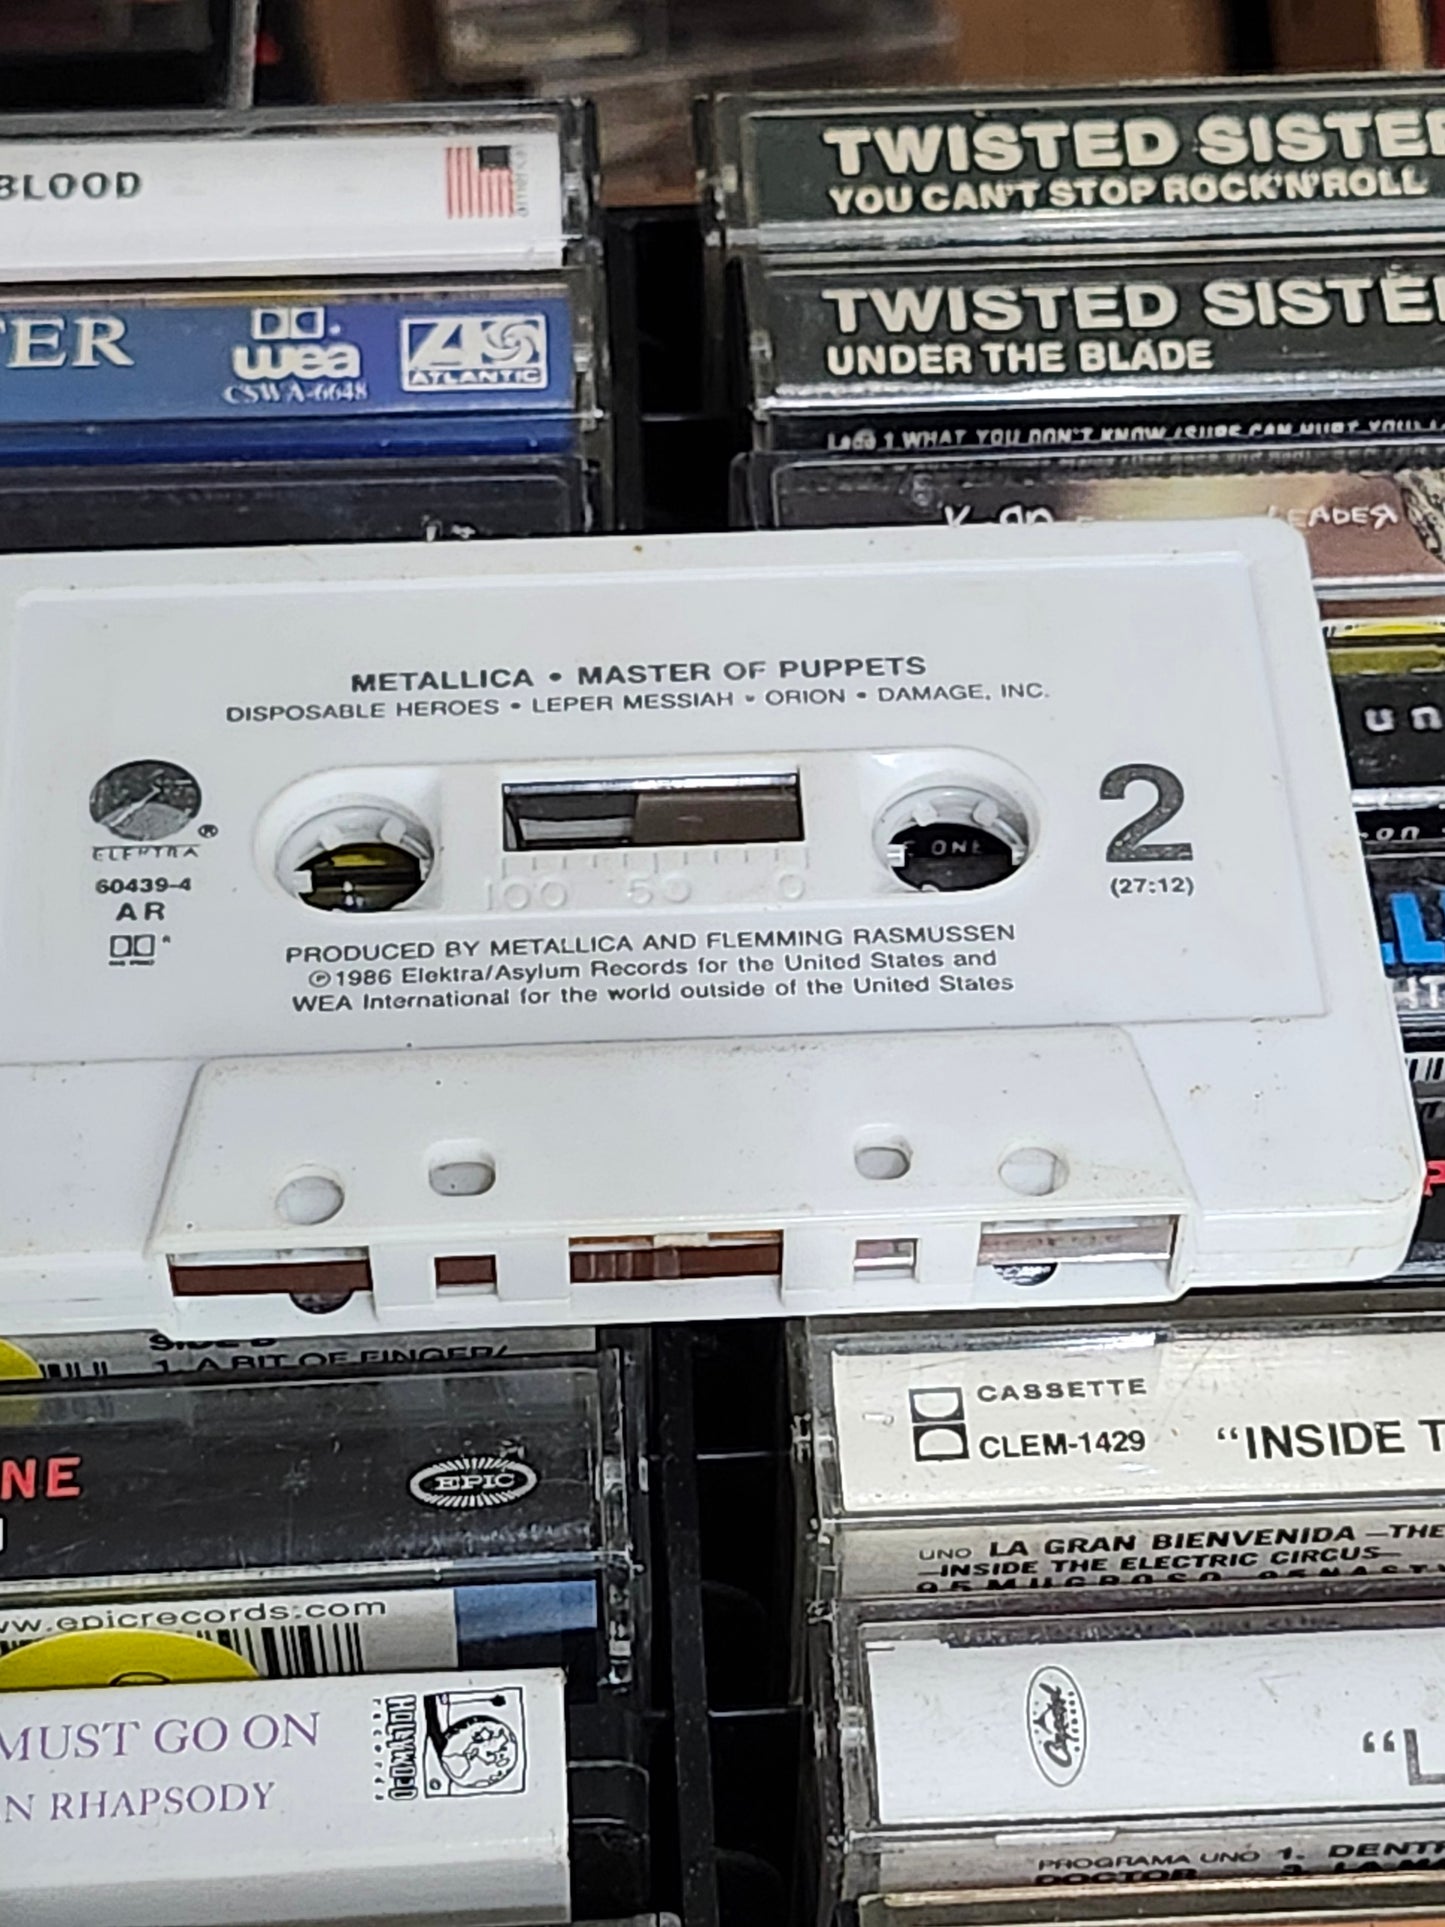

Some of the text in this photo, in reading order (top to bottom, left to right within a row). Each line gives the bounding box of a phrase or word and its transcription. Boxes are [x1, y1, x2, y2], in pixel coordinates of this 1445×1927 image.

[823, 118, 1180, 176] TWISTED
[0, 172, 141, 200] BLOOD
[828, 183, 918, 215] YOU
[922, 180, 1038, 211] CAN'T
[1049, 174, 1150, 208] STOP
[822, 283, 1179, 334] TWISTED
[0, 316, 135, 368] ER
[826, 338, 1214, 376] UNDER THE BLADE
[232, 342, 362, 380] wea
[409, 368, 542, 386] ATLANTIC
[902, 428, 967, 450] WHAT
[976, 427, 1020, 447] YOU
[351, 656, 927, 693] METALLICA MASTER OF PUPPETS
[227, 682, 1050, 723] DISPOSABLE HEROES LEPER MESSIAH ORION DAMAGE, INC.
[1099, 762, 1194, 863] 2
[95, 876, 193, 895] 60439-4
[1109, 876, 1195, 899] (27:12)
[286, 923, 1016, 963] PRODUCED BY METALLICA AND FLEMMING RASMUSSEN
[401, 963, 580, 985] Elektra/Asylum
[591, 956, 689, 977] Records
[699, 956, 728, 974] for
[738, 955, 774, 973] the
[785, 952, 861, 971] United
[870, 951, 944, 970] States
[953, 949, 997, 967] and
[292, 974, 1015, 1013] WEA International for the world outside of the United States
[977, 1377, 1148, 1403] CASSETTE
[979, 1430, 1147, 1460] CLEM-1429
[434, 1471, 516, 1491] EPIC
[918, 1547, 972, 1562] UNO
[989, 1539, 1030, 1558] LA
[1044, 1534, 1137, 1556] GRAN
[1151, 1525, 1357, 1551] BIENVENIDA
[1051, 1557, 1109, 1573] THE
[1120, 1552, 1259, 1572] ELECTRIC
[154, 1715, 229, 1755] GO
[243, 1710, 321, 1751] ON
[50, 1781, 275, 1821] RHAPSODY
[1039, 1852, 1191, 1872] PROGRAMA
[1200, 1849, 1261, 1864] UNO
